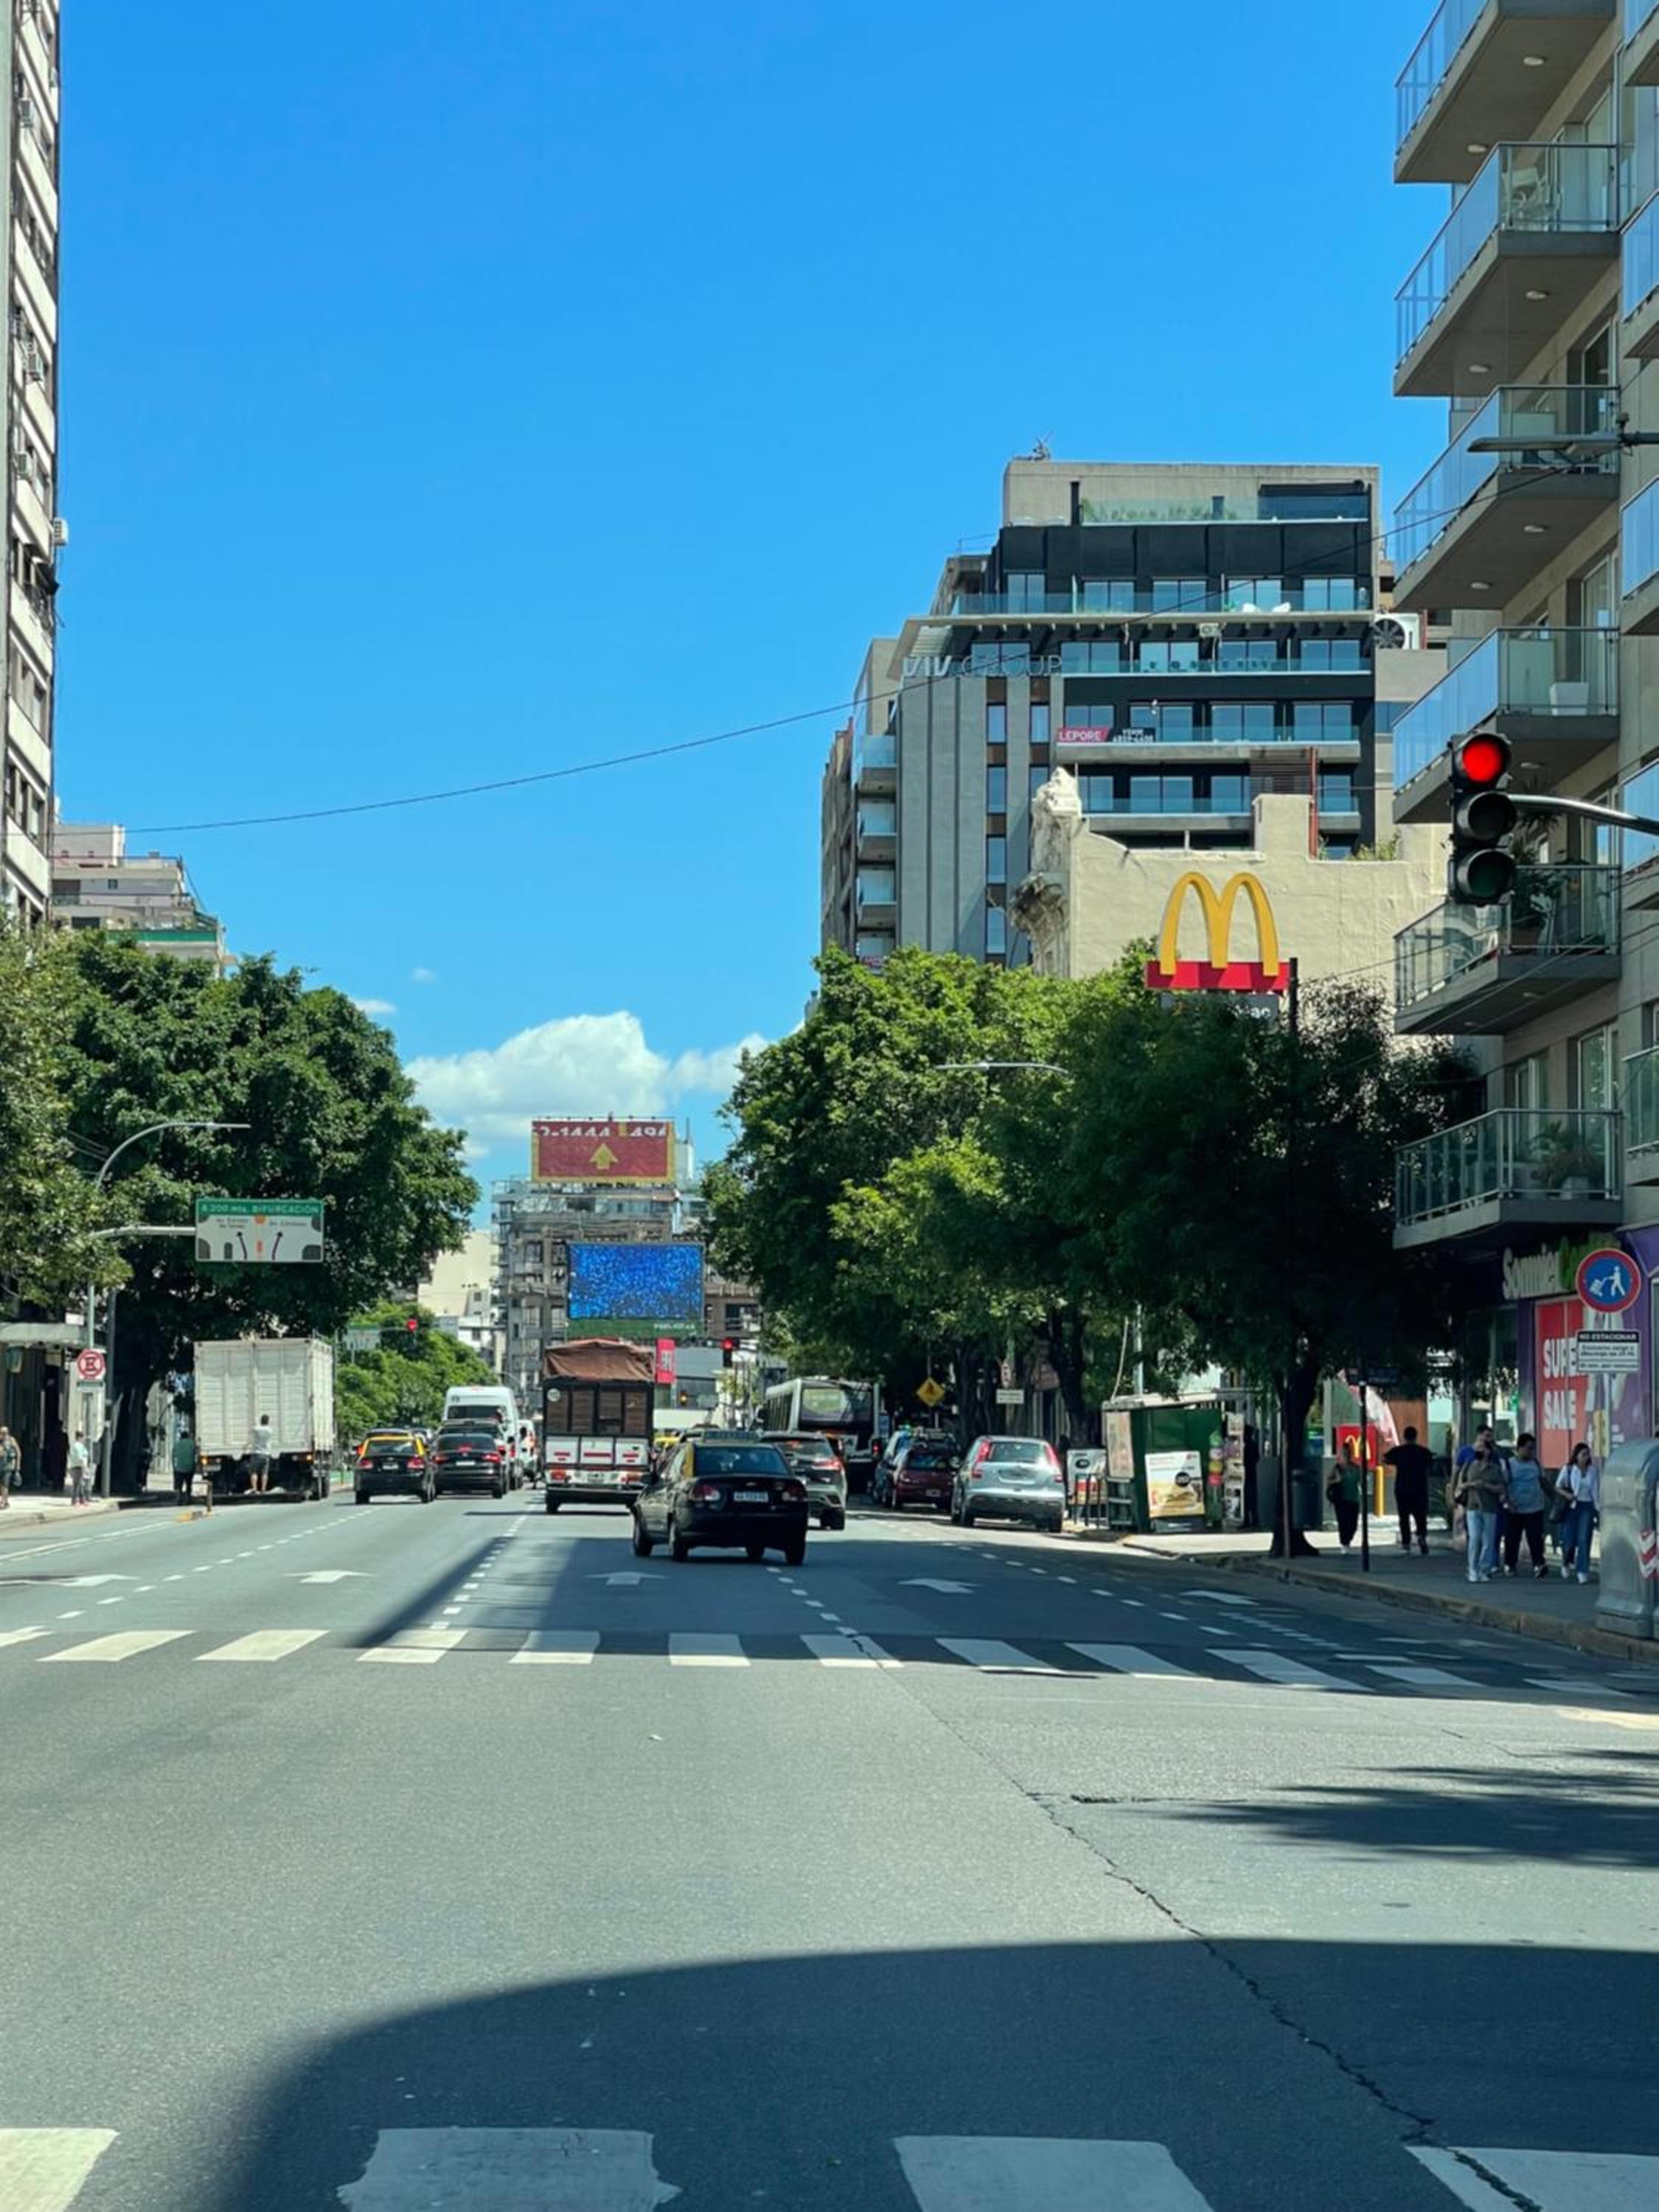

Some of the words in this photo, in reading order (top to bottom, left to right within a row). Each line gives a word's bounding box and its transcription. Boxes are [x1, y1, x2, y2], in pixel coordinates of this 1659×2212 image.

[1059, 730, 1102, 742] LEPORE
[1543, 1337, 1578, 1379] SUPE
[1543, 1389, 1577, 1430] SALE
